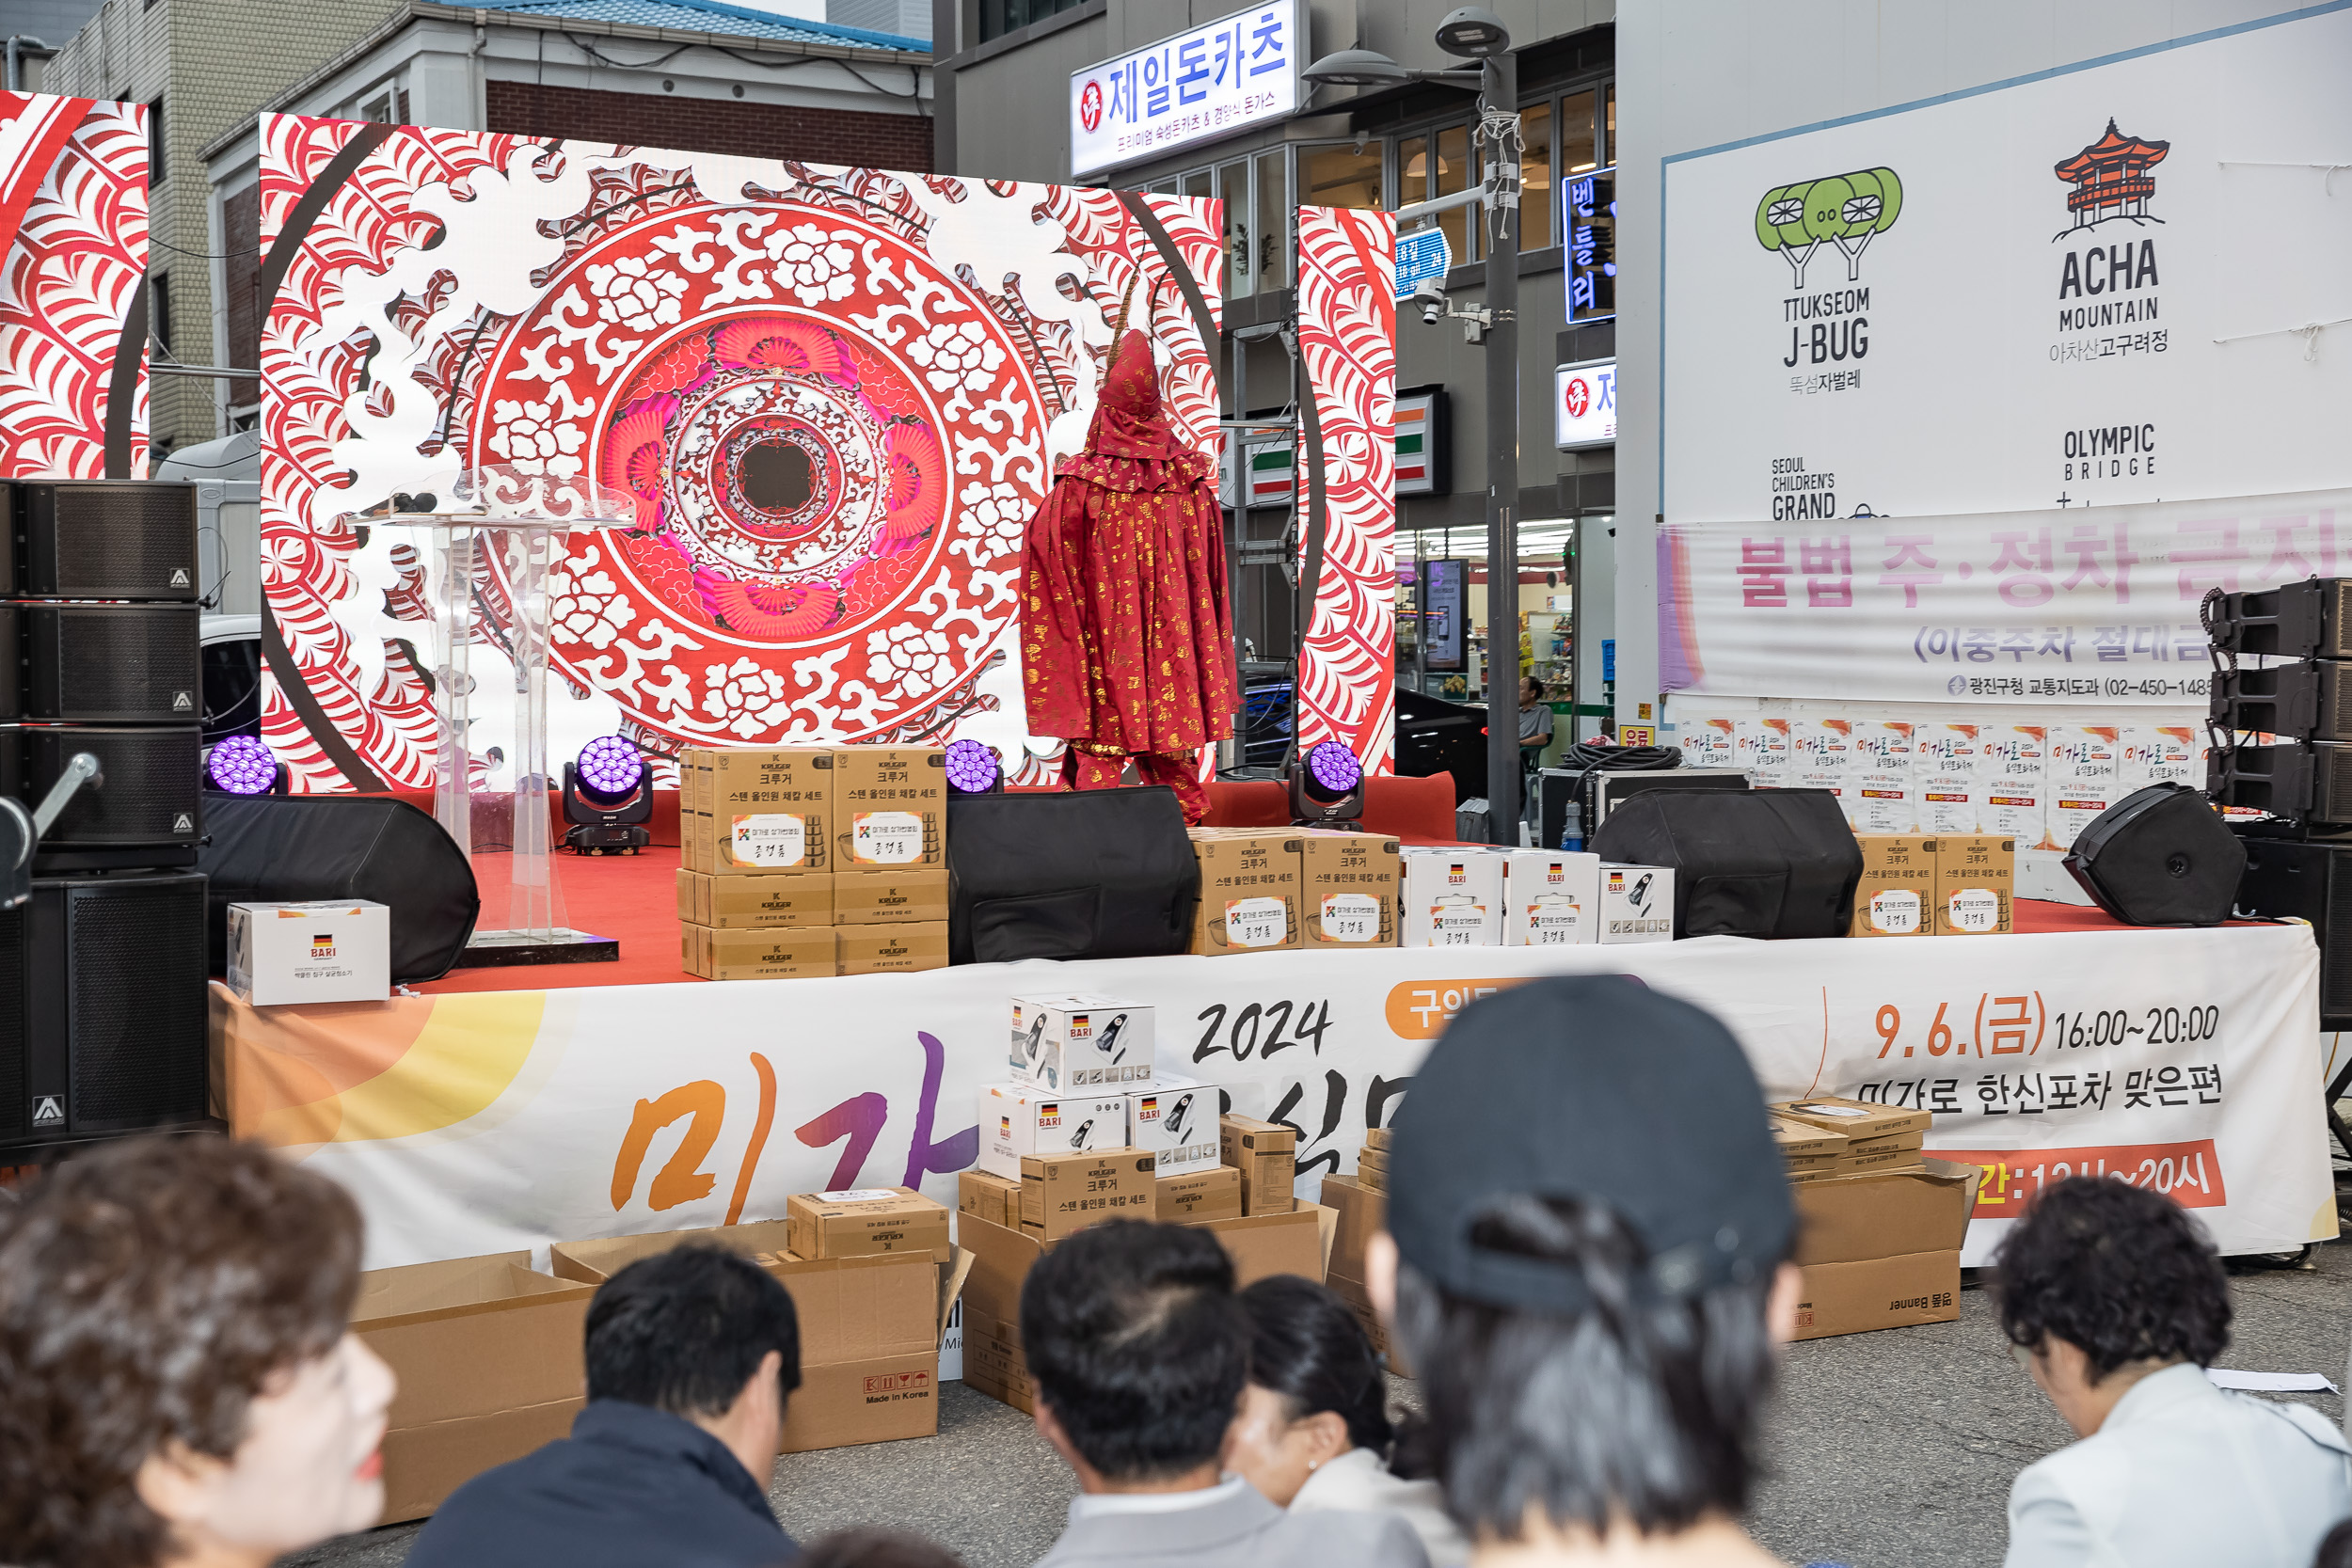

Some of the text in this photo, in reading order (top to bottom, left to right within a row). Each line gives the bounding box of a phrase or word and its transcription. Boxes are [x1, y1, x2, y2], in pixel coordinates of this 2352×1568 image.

[1108, 12, 1285, 123] 제일돈카츠
[1118, 128, 1152, 151] 프리미엄
[1156, 114, 1200, 140] 숙성돈카츠
[1215, 103, 1241, 125] 경양식
[1245, 91, 1275, 115] 돈가스
[2059, 239, 2159, 300] ACHA
[1784, 287, 1869, 322] TTUKSEOM
[2059, 296, 2159, 332] MOUNTAIN
[1784, 317, 1868, 367] J-BUG
[2049, 328, 2169, 364] 아차산고구려정
[1789, 369, 1861, 395] 뚝섬자벌레
[2064, 423, 2154, 459] OLYMPIC
[1772, 456, 1805, 474] SEOUL
[2064, 456, 2155, 481] BRIDGE
[1772, 472, 1835, 492] CHILDREN'S
[1772, 492, 1836, 521] GRAND
[1736, 535, 1853, 608] 불법
[1914, 624, 2211, 663] (이중주차 절대금
[1970, 677, 2023, 695] 광진구청
[2029, 677, 2099, 696] 교통지도과
[1684, 735, 1712, 752] 미가로
[1739, 736, 1769, 752] 미가로
[1795, 736, 1828, 754] 미가로
[1857, 737, 1889, 755] 미가로
[1919, 738, 1954, 758] 미가로
[1984, 741, 2020, 761] 미가로
[2053, 743, 2090, 763] 미가로
[2124, 743, 2165, 765] 미가로
[760, 773, 791, 784] 크루거
[877, 771, 909, 783] 크루거
[729, 791, 823, 801] 스텐 올인원 채칼 세트
[848, 788, 937, 800] 스텐 올인원 채칼 세트
[1240, 858, 1267, 869] 크루거
[1341, 857, 1366, 867] 크루거
[1886, 855, 1909, 864] 크루거
[1966, 855, 1988, 863] 크루거
[1216, 873, 1294, 886] 스텐 올인원 채칼 세트
[1315, 874, 1331, 882] 스텐
[1333, 874, 1356, 882] 올인원
[1359, 874, 1374, 882] 채칼
[310, 948, 336, 957] BARI
[1410, 987, 1498, 1028] 구의
[1071, 1028, 1092, 1038] BARI
[1192, 999, 1334, 1064] 2024
[2054, 1004, 2220, 1050] 16:00~20:00
[1858, 1063, 2223, 1116] 미가로 한신포차 맞은편
[1039, 1117, 1061, 1127] BARI
[1139, 1109, 1160, 1120] BARI
[611, 1031, 979, 1227] 미가
[1088, 1179, 1118, 1192] 크루거
[1059, 1195, 1146, 1212] 스텐 올인원 채칼 세트
[1889, 1292, 1952, 1311] 명품 Banner
[945, 1337, 963, 1352] Mi
[866, 1390, 929, 1404] Made in Korea
